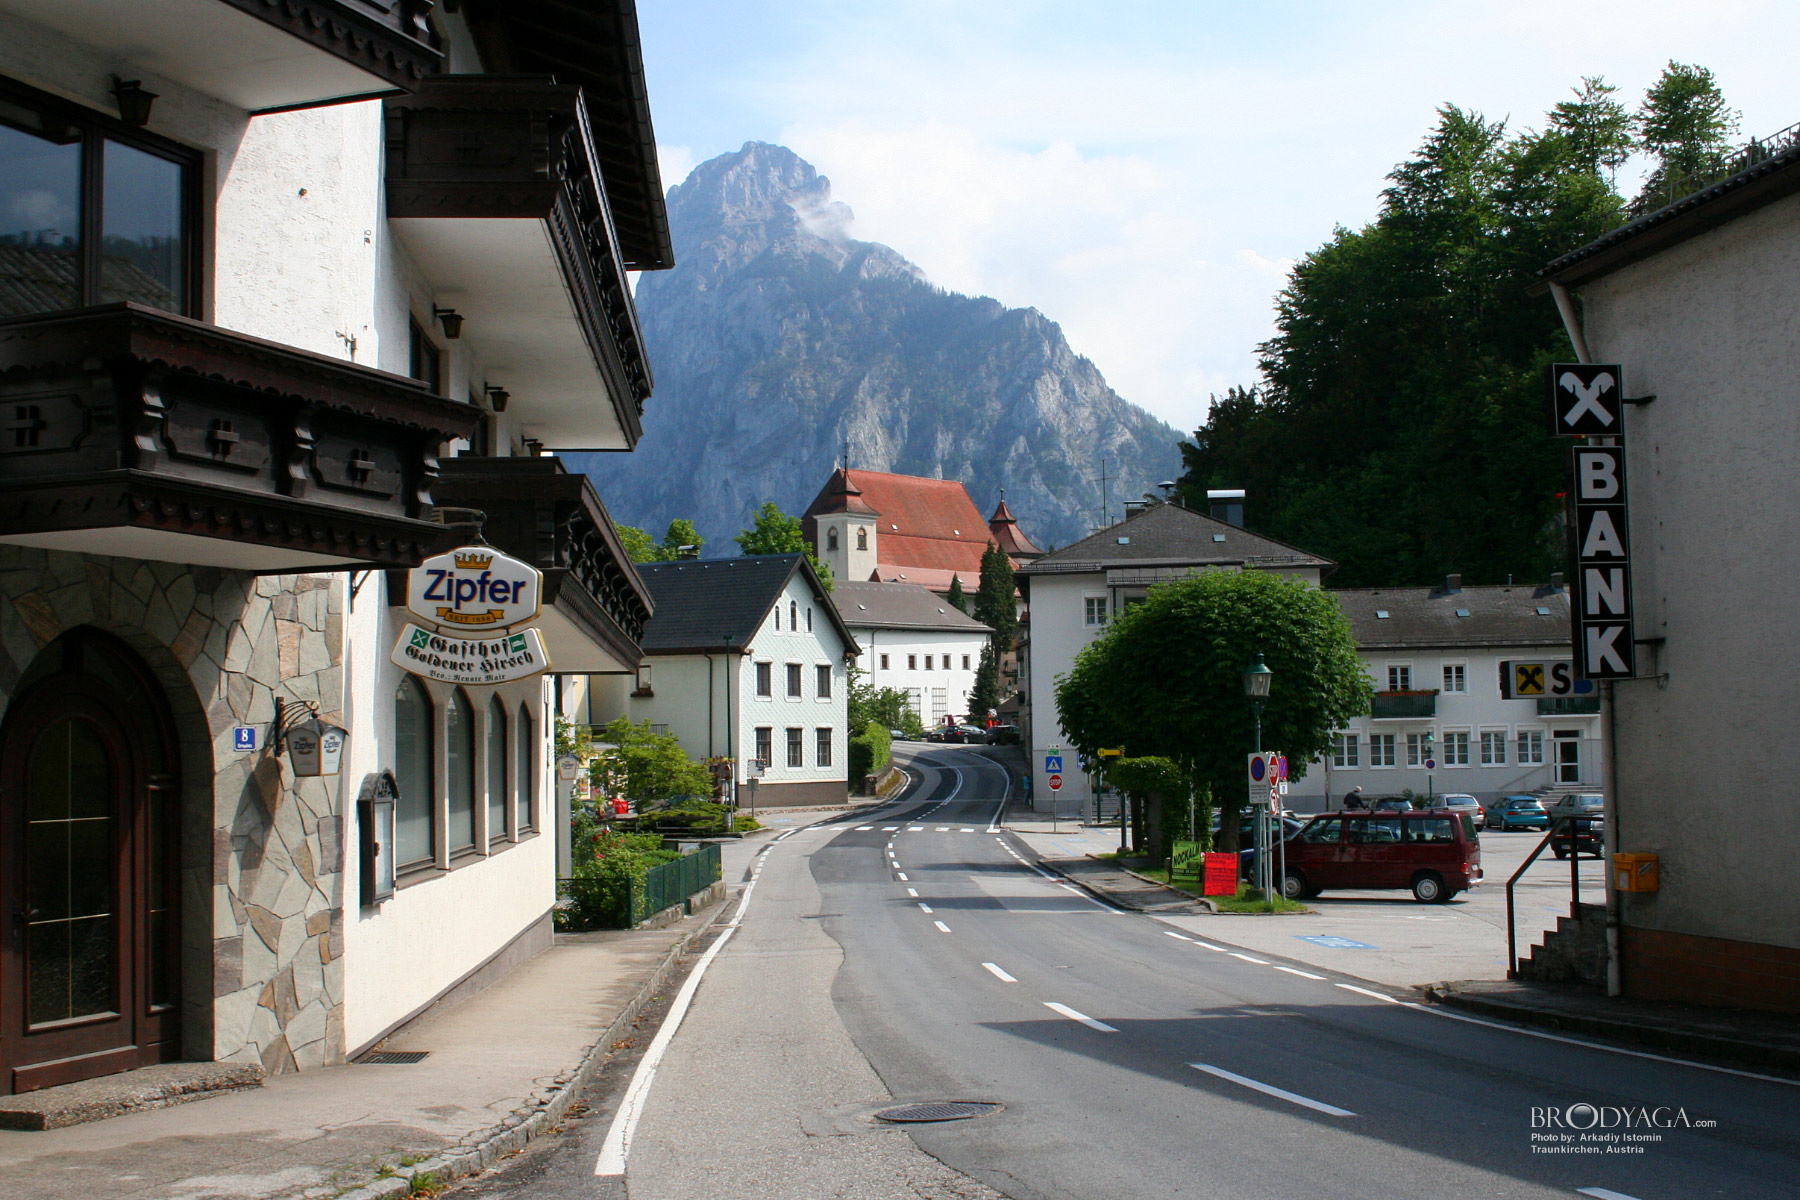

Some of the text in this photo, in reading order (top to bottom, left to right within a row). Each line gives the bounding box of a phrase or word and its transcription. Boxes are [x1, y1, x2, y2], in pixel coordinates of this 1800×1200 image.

[1579, 452, 1629, 673] BANK
[423, 569, 526, 609] Zipfer
[405, 645, 534, 674] Goldener Hirsch
[241, 728, 249, 742] 8
[1270, 764, 1278, 777] STOP
